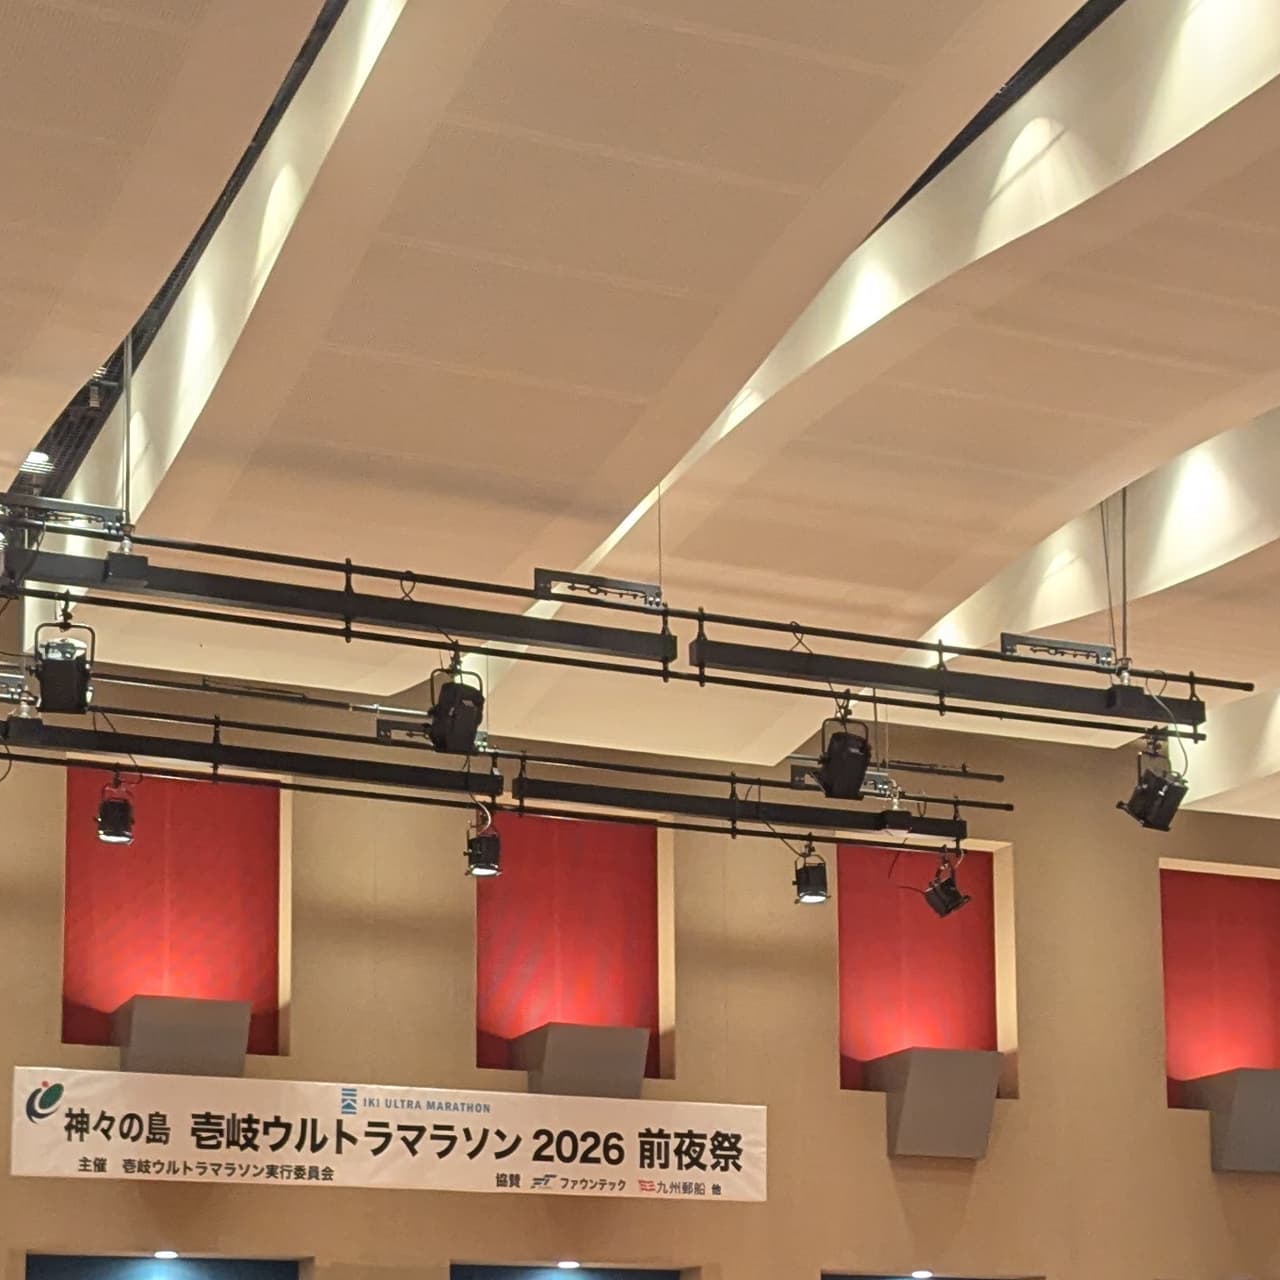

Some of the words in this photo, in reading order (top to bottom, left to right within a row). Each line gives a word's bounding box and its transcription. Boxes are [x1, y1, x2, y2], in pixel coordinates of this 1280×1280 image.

[363, 1097, 380, 1108] IKI
[385, 1098, 421, 1110] ULTRA
[426, 1100, 491, 1113] MARATHON
[64, 1107, 171, 1145] 神々の島
[191, 1112, 522, 1160] 壱岐ウルトラマラソン
[532, 1128, 625, 1166] 2026
[638, 1127, 744, 1172] 前夜祭
[78, 1156, 108, 1173] 主催
[122, 1158, 335, 1181] 壱岐ウルトラマラソン実行委員会
[496, 1172, 521, 1189] 協賛
[560, 1177, 627, 1192] ファウンテック
[656, 1181, 706, 1195] 九州郵船
[712, 1184, 722, 1196] 他
